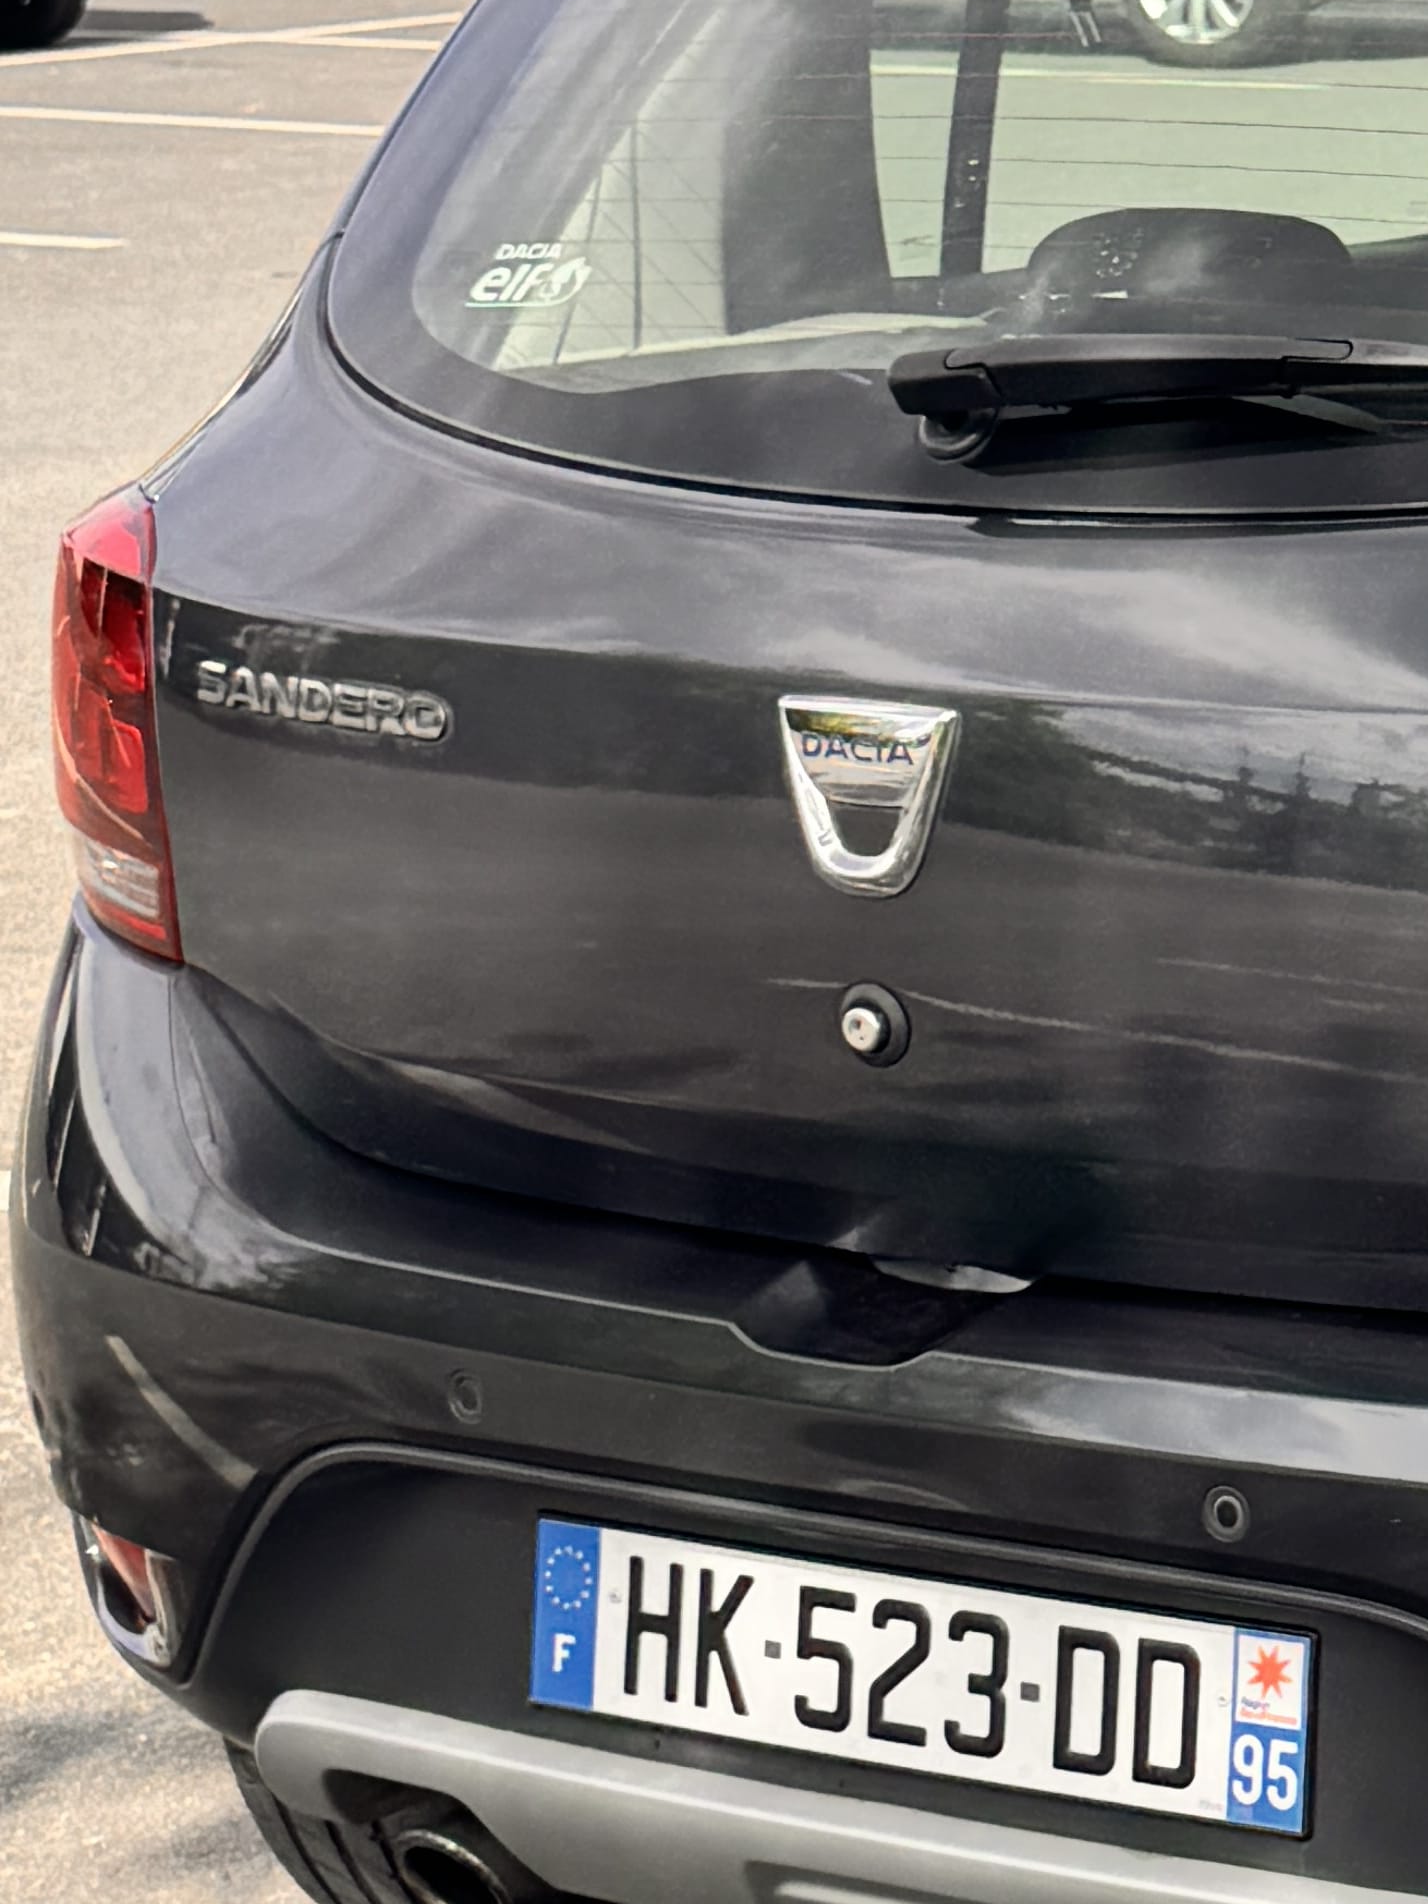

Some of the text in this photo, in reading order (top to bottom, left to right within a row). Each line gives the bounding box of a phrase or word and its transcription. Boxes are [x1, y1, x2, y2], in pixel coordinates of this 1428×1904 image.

[494, 243, 563, 261] DACIA
[469, 262, 555, 302] elf
[196, 659, 449, 742] SANDERO
[800, 730, 914, 766] DACIA
[551, 1632, 577, 1673] F
[1231, 1733, 1299, 1811] 95
